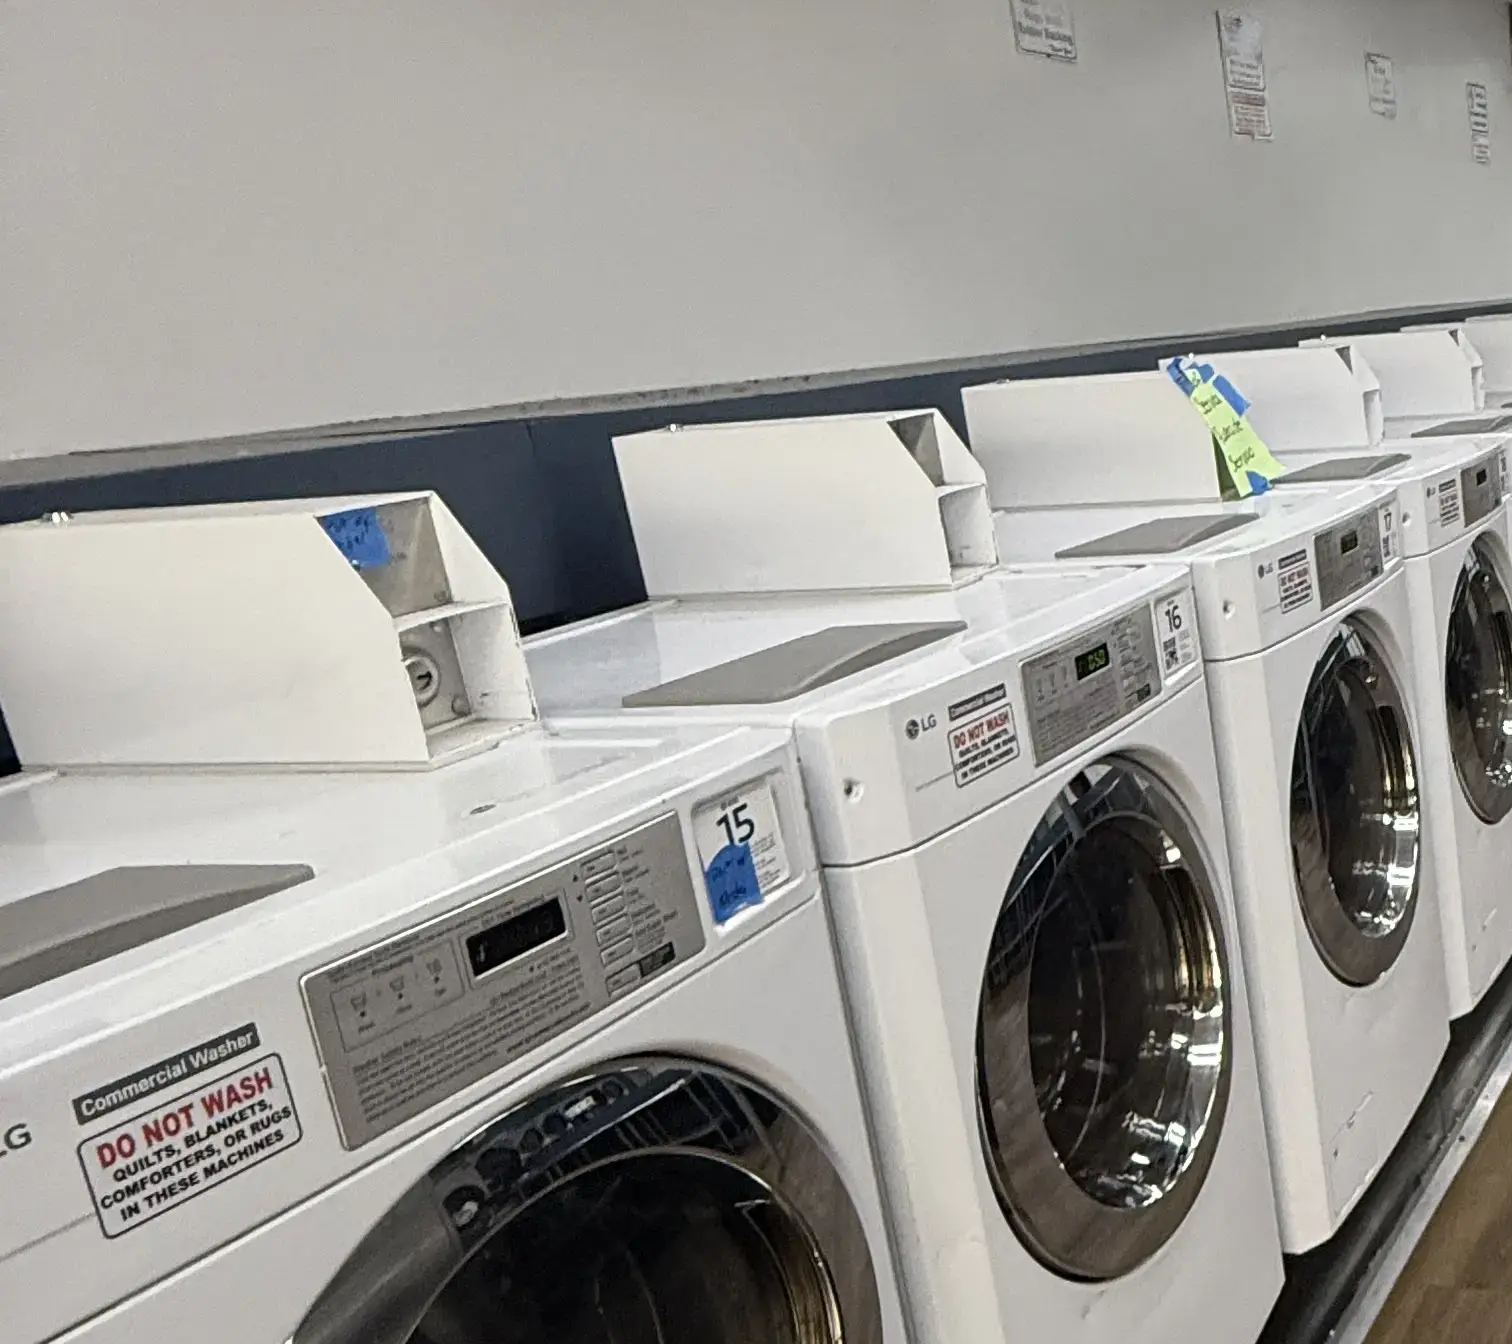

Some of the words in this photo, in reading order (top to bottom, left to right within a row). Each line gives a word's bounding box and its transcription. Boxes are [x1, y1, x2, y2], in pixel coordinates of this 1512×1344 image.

[1165, 605, 1182, 632] 16
[920, 714, 937, 732] LG
[967, 722, 985, 742] NOT
[716, 803, 755, 844] 15
[81, 1059, 187, 1116] Commercial
[189, 1031, 253, 1069] Washer
[0, 1122, 32, 1158] G
[96, 1137, 136, 1168] DO
[142, 1103, 194, 1148] NOT
[201, 1067, 273, 1118] WASH
[113, 1143, 181, 1183] QUILTS,
[185, 1099, 273, 1149] BLANKETS,
[100, 1143, 222, 1209] COMFORTERS,
[224, 1128, 247, 1148] OR
[250, 1106, 292, 1136] RUGS
[120, 1202, 140, 1221] IN
[144, 1172, 200, 1208] THESE
[203, 1130, 284, 1179] MACHINES
